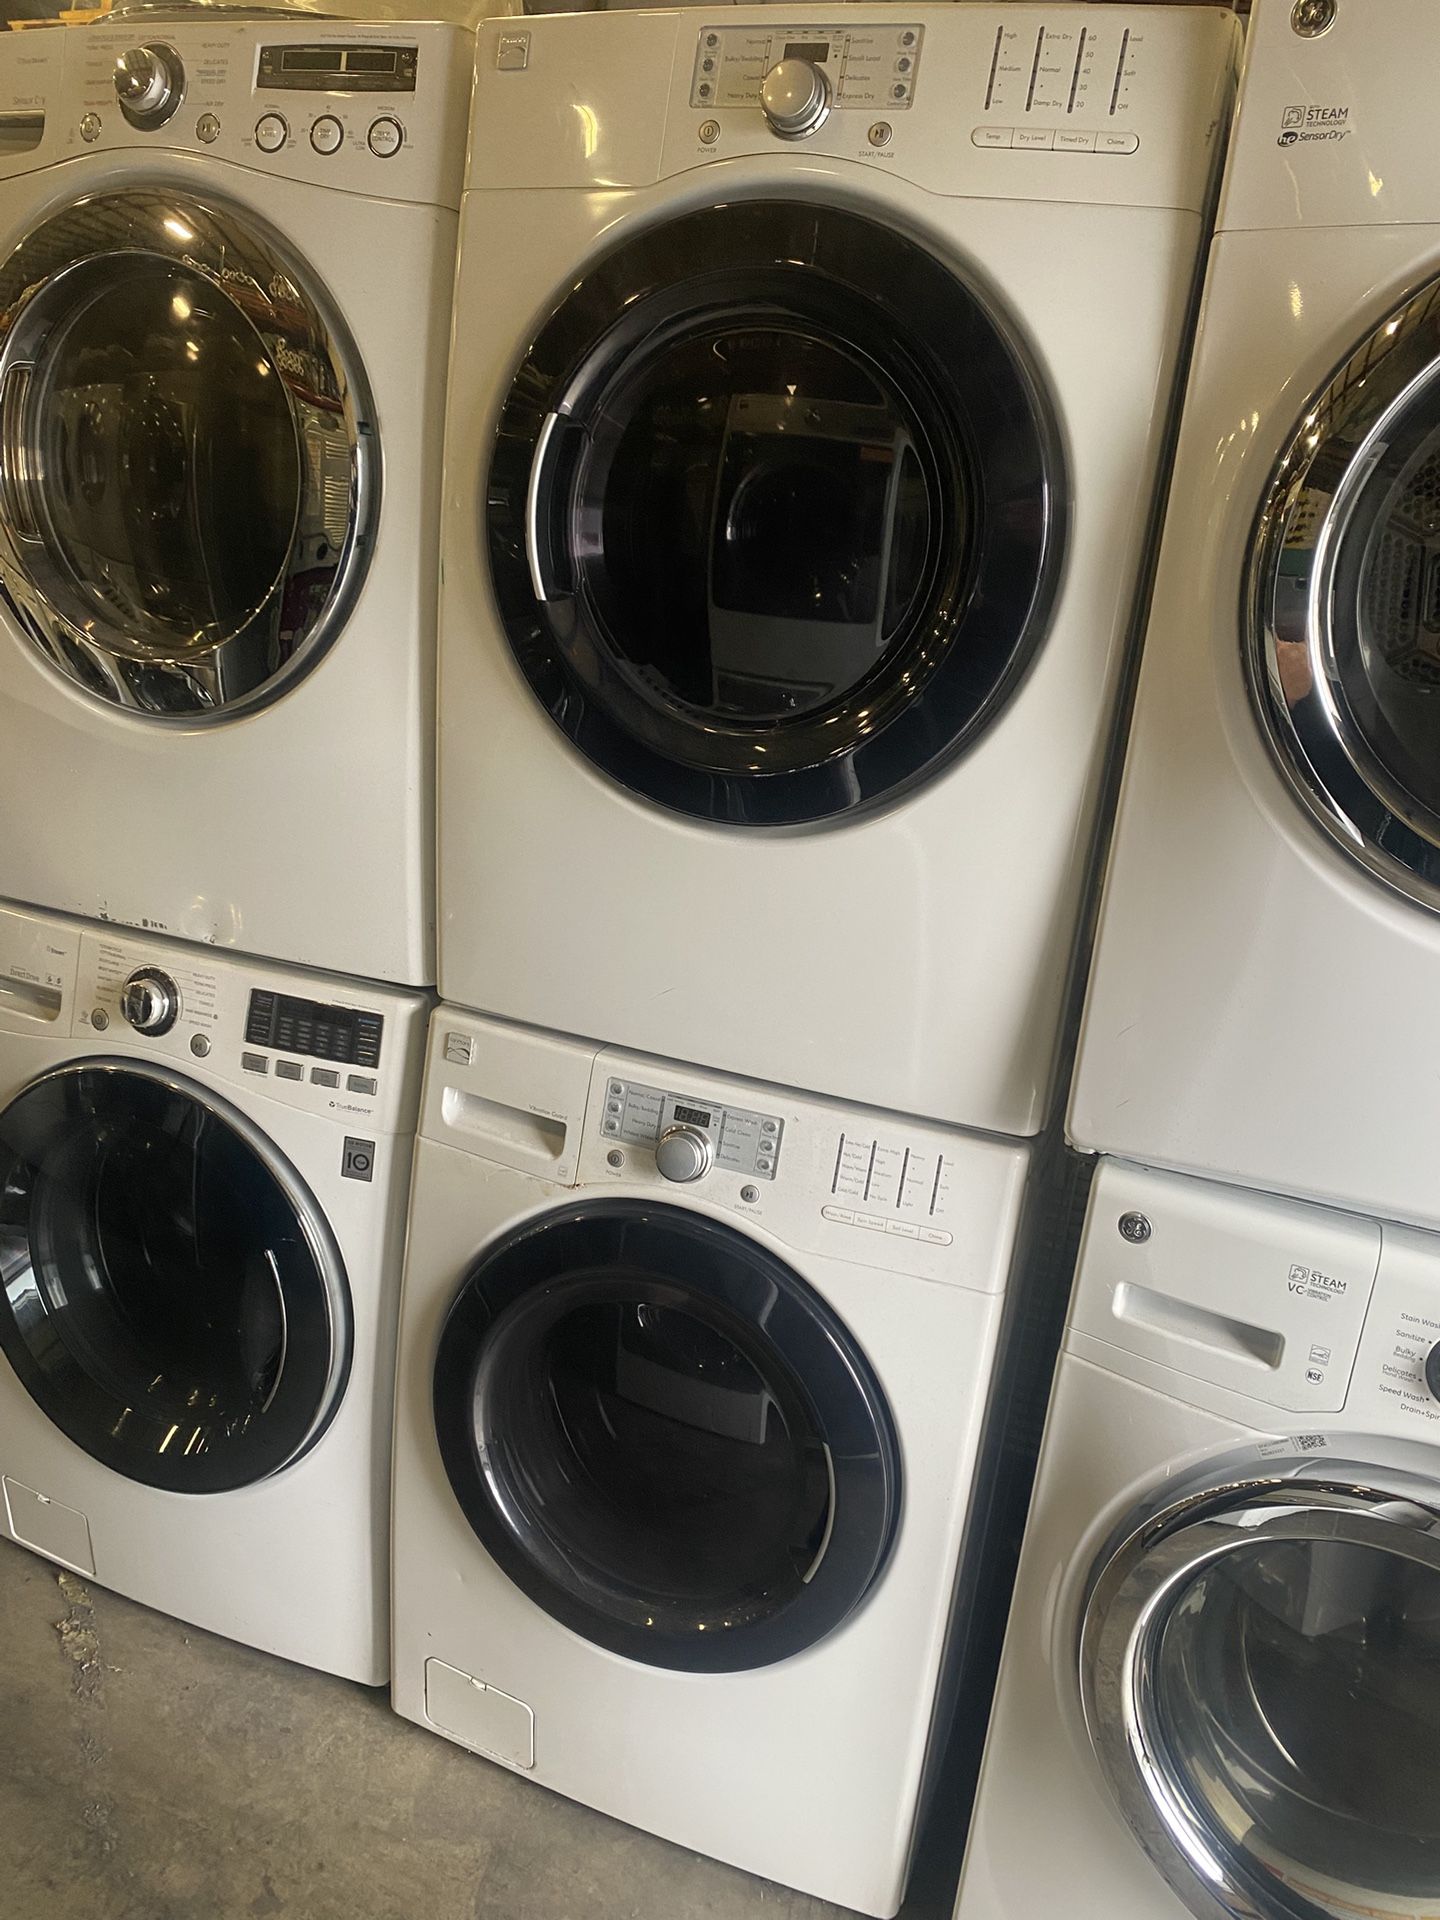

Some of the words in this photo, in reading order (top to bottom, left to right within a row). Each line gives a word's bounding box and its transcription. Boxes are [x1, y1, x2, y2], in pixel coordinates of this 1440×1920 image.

[1033, 100, 1051, 108] Damp
[1306, 107, 1349, 121] STEAM
[1306, 119, 1347, 127] TECHNOLOGY
[1288, 1282, 1304, 1295] VC
[1310, 1273, 1347, 1291] STEAM
[1310, 1282, 1345, 1295] TECHNOLOGY
[1307, 1288, 1332, 1299] VIBRATION
[1401, 1312, 1420, 1324] Stain
[1396, 1329, 1426, 1343] Sanitize
[1393, 1351, 1416, 1363] Bedding
[1395, 1345, 1417, 1358] Bulky
[1382, 1364, 1417, 1379] Delicates
[1382, 1370, 1397, 1379] Hand
[1398, 1374, 1415, 1383] Wash
[1379, 1384, 1402, 1396] Speed
[1403, 1392, 1425, 1403] Wash
